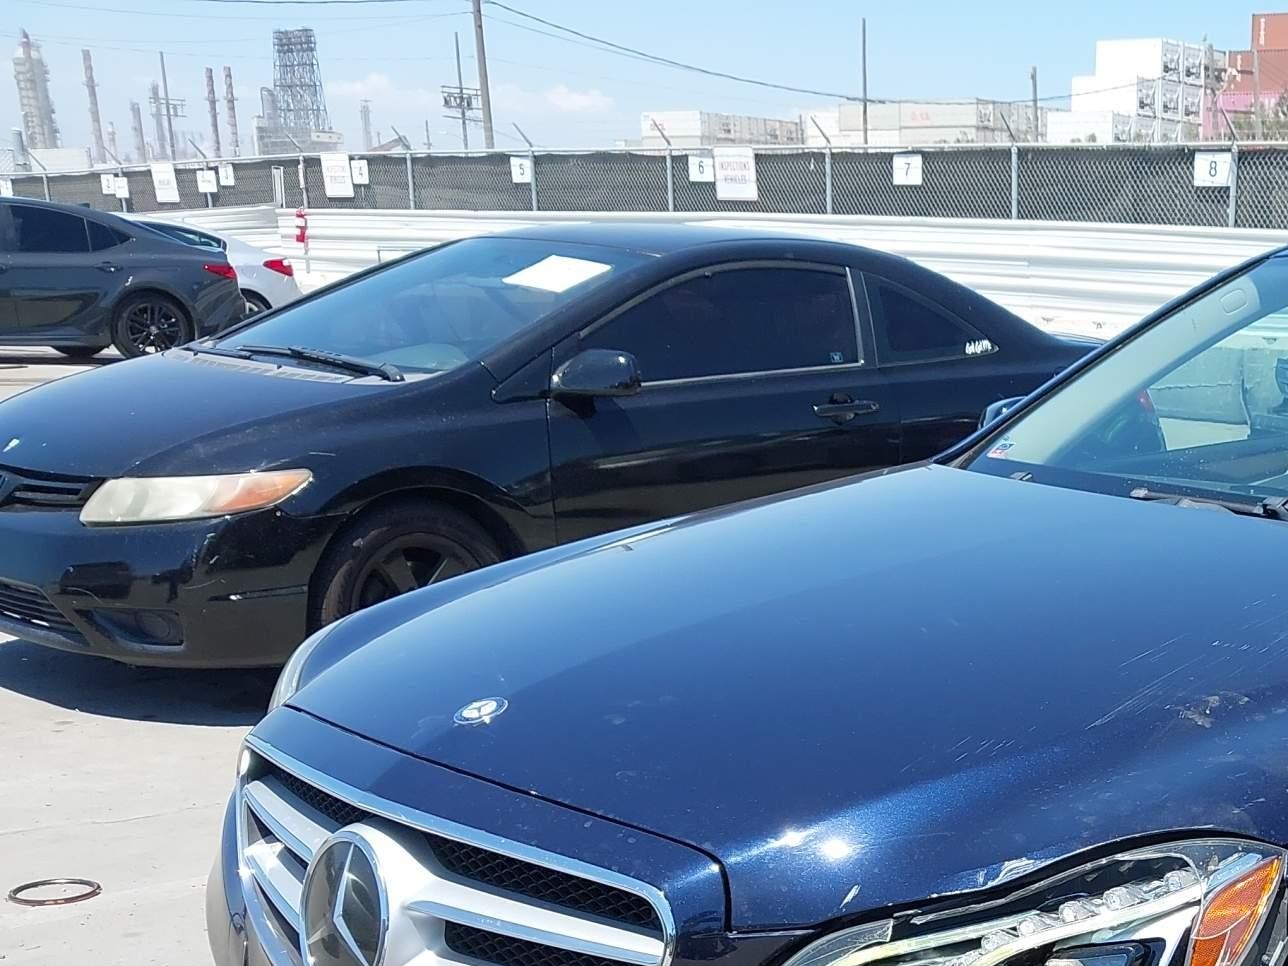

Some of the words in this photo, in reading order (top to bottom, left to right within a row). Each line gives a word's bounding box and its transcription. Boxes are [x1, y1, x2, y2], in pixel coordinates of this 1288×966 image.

[518, 162, 525, 176] 5
[698, 160, 705, 175] 6
[903, 162, 911, 177] 7
[1208, 160, 1217, 177] 8
